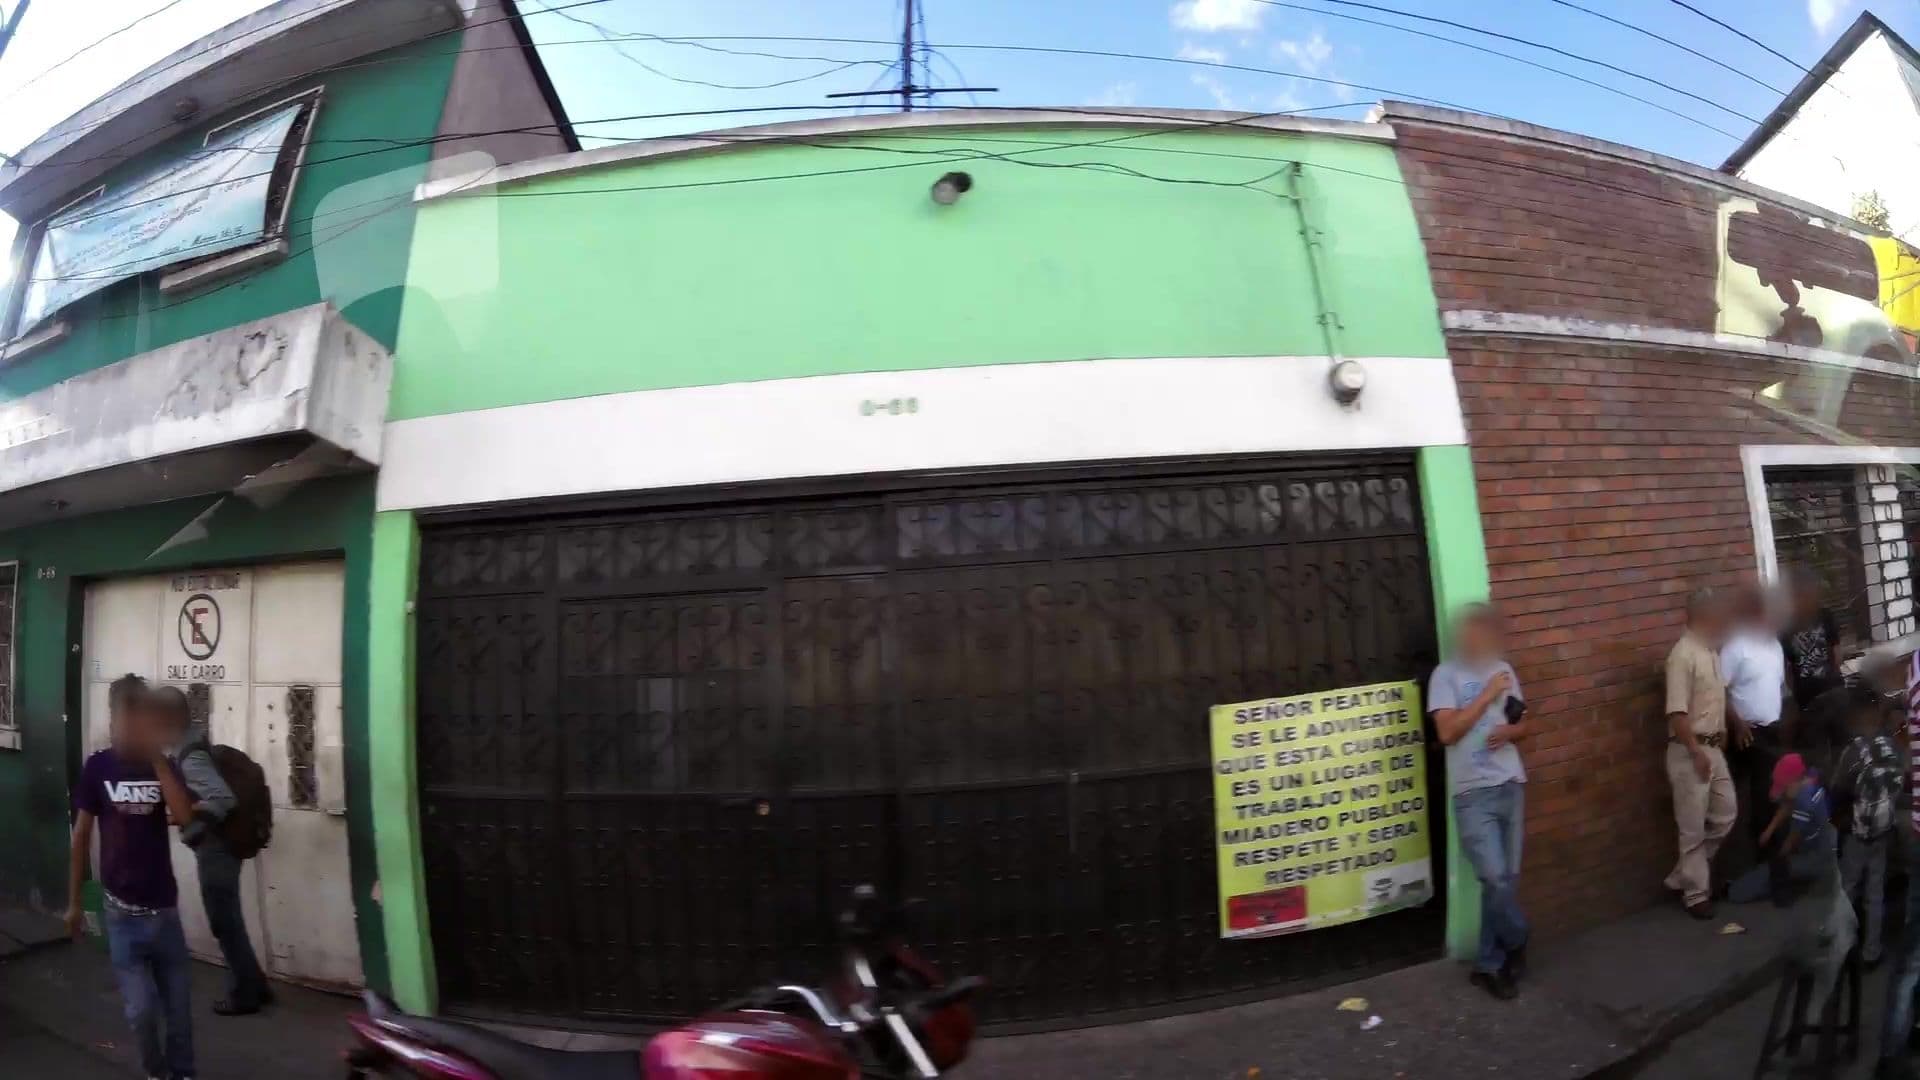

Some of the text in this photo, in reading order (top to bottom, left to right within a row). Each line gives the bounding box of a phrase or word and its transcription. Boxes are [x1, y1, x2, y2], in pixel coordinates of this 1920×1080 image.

[168, 664, 225, 680] SALE CARRO
[1234, 687, 1404, 724] SEÑOR PEATON
[1232, 709, 1408, 748] SE LE ADVIERTE
[1216, 730, 1424, 775] QUE ESTA CUADRA
[104, 781, 161, 803] VANS
[1232, 753, 1414, 797] ES UN LUGAR DE
[1235, 776, 1414, 820] TRABAJO NO UN
[1222, 797, 1425, 844] MIADERO PUBLICO
[1234, 820, 1418, 867] RESPETE Y SERA
[1265, 848, 1396, 884] RESPETADO
